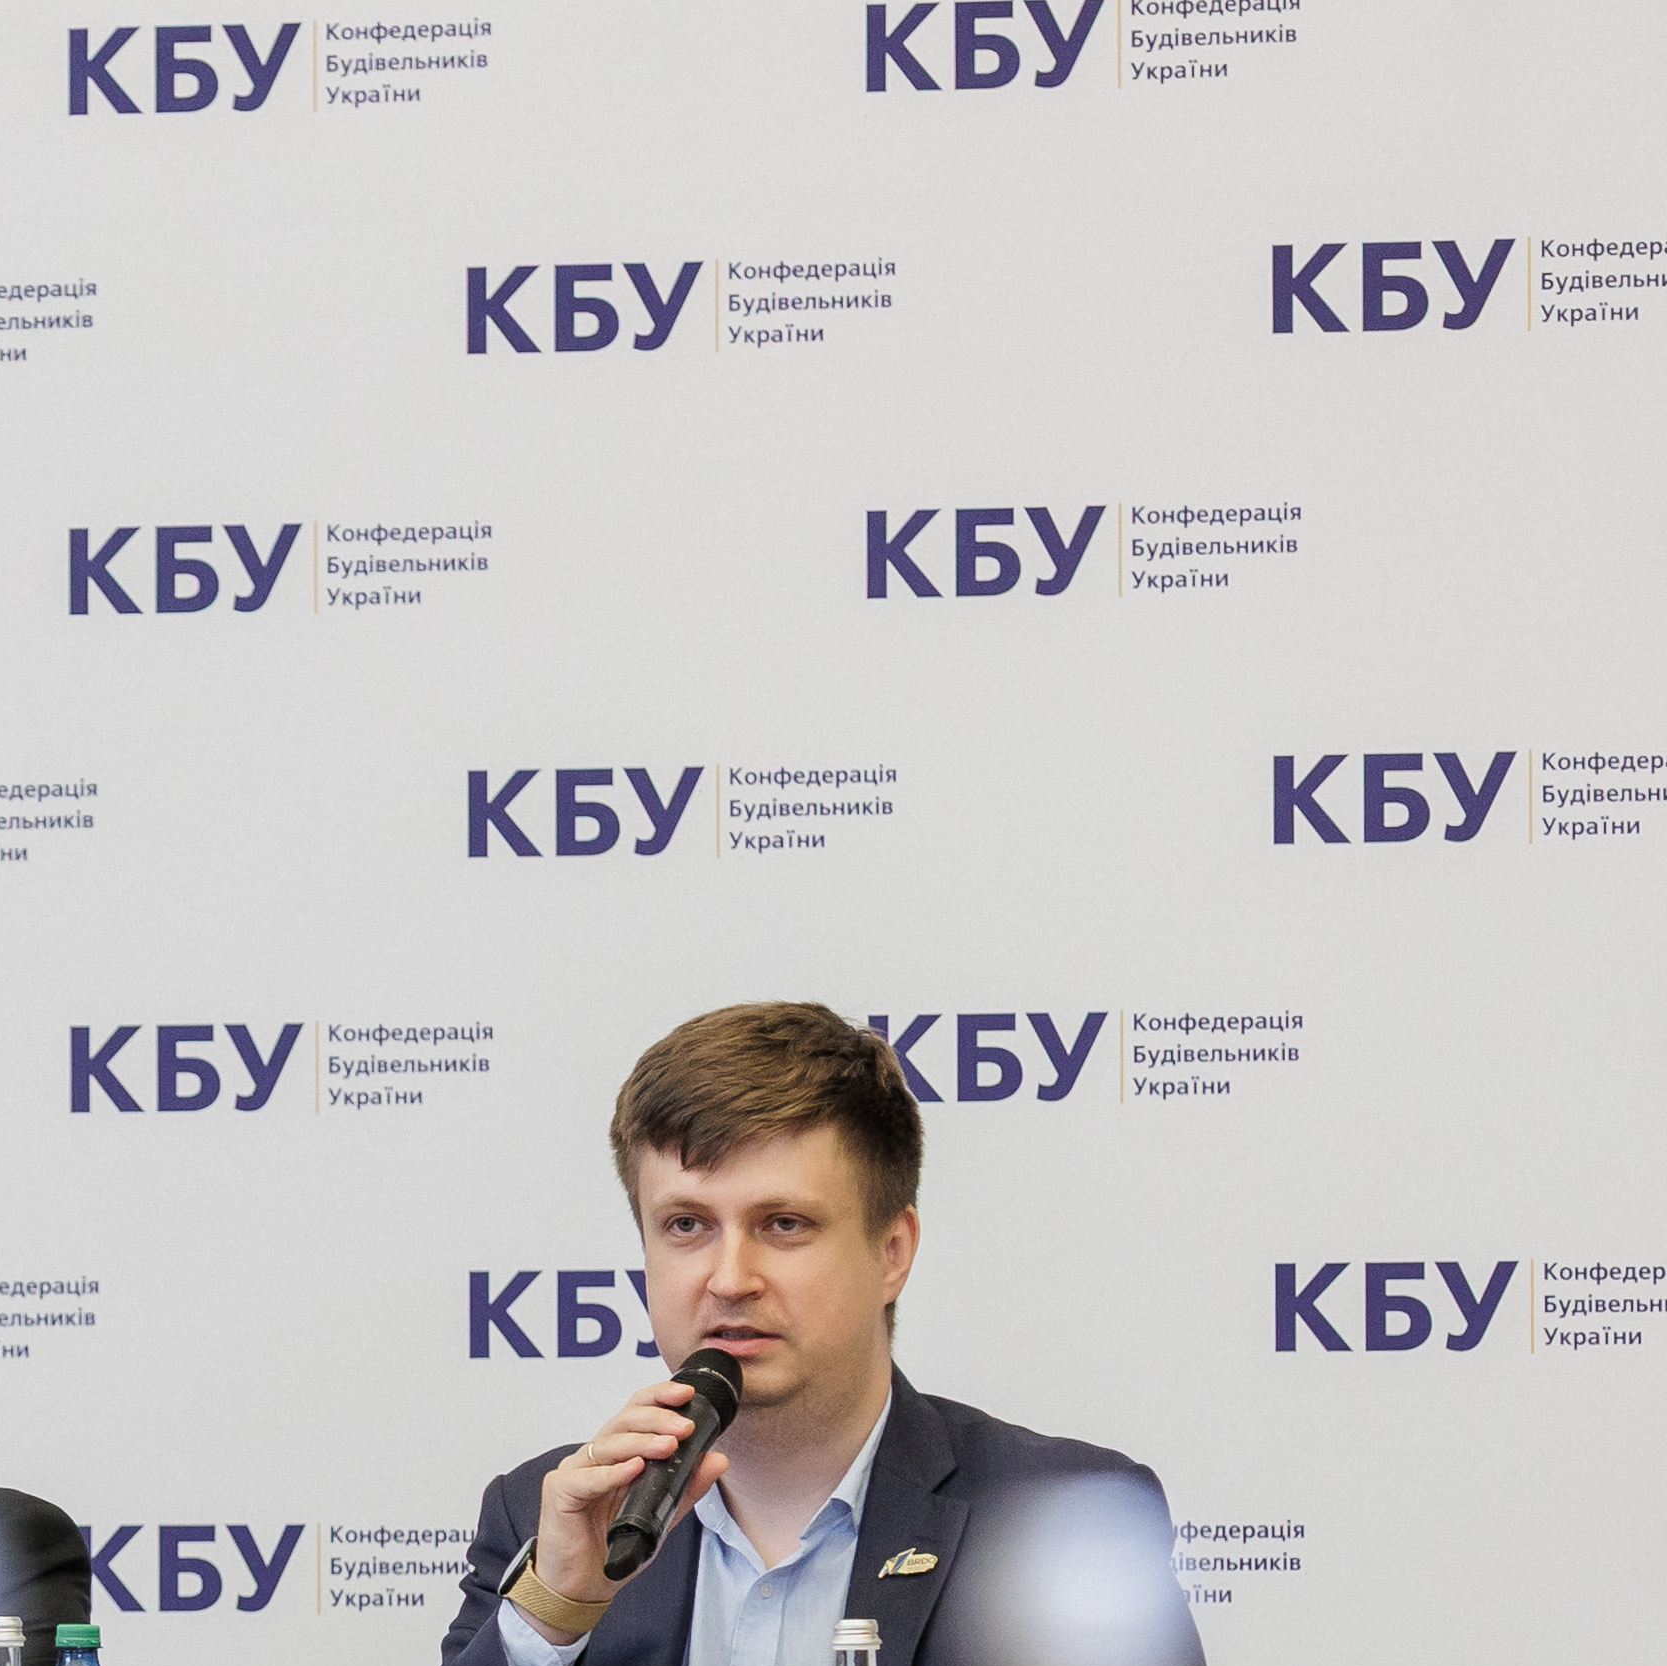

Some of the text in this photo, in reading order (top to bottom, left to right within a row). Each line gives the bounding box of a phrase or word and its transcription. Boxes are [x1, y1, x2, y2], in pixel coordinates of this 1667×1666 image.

[1130, 0, 1301, 20] Конфедерація
[326, 17, 492, 45] Конфедерація
[1131, 23, 1297, 53] Будівельників
[866, 0, 1105, 93] КБУ
[68, 22, 301, 116] КБУ
[326, 49, 489, 78] Будівельників
[1130, 59, 1228, 85] України
[326, 83, 421, 109] України
[1541, 238, 1666, 262] Конфедер
[1272, 238, 1516, 334] КБУ
[466, 261, 703, 355] КБУ
[1540, 301, 1639, 328] України
[1131, 501, 1302, 529] Конфедерація
[866, 505, 1106, 599] КБУ
[1131, 534, 1298, 562] Будівельників
[69, 523, 302, 616] КБУ
[1131, 568, 1229, 594] України
[1542, 751, 1666, 775] Конфедер
[1273, 751, 1517, 845] КБУ
[467, 766, 704, 858] КБУ
[1542, 815, 1641, 841] України
[1133, 1009, 1304, 1036] Конфедерація
[70, 1023, 304, 1114] КБУ
[868, 1011, 1108, 1102] КБУ
[1133, 1042, 1300, 1069] Будівельників
[1133, 1075, 1231, 1101] України
[1275, 1260, 1519, 1352] КБУ
[1543, 1326, 1642, 1351] України
[330, 1525, 476, 1546] Конфедерац
[1174, 1520, 1305, 1544] федерація
[330, 1556, 471, 1579] Будівельник
[1171, 1552, 1301, 1573] івельників
[330, 1588, 426, 1612] України
